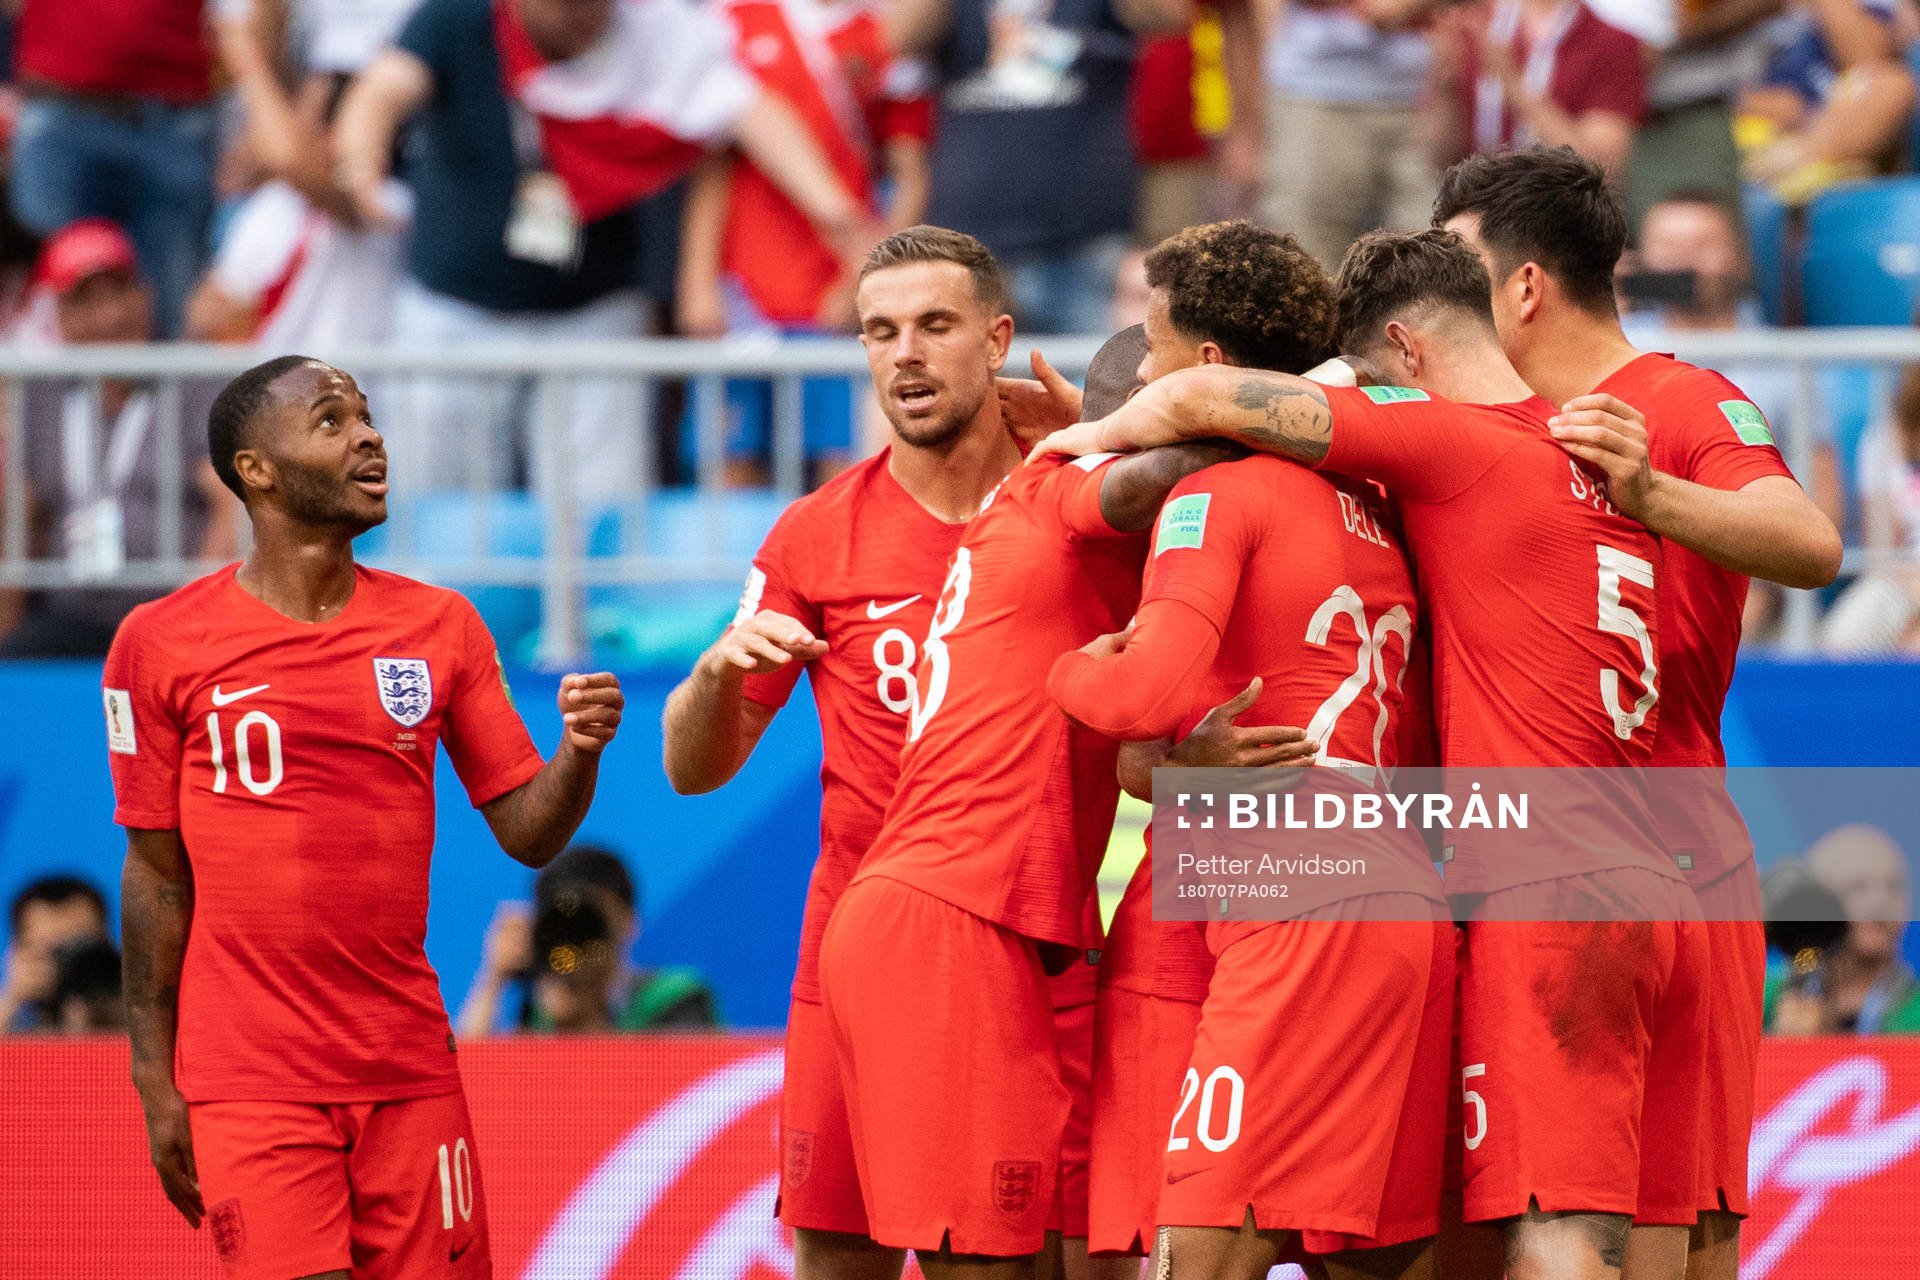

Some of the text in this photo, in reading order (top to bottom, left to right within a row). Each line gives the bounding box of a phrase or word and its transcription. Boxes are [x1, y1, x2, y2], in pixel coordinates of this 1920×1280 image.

[873, 628, 920, 714] 8
[1596, 544, 1659, 741] 5
[1304, 584, 1412, 793] 20
[207, 710, 284, 796] 10
[1167, 1065, 1244, 1152] 20
[1462, 1063, 1487, 1150] 5
[438, 1137, 473, 1229] 10
